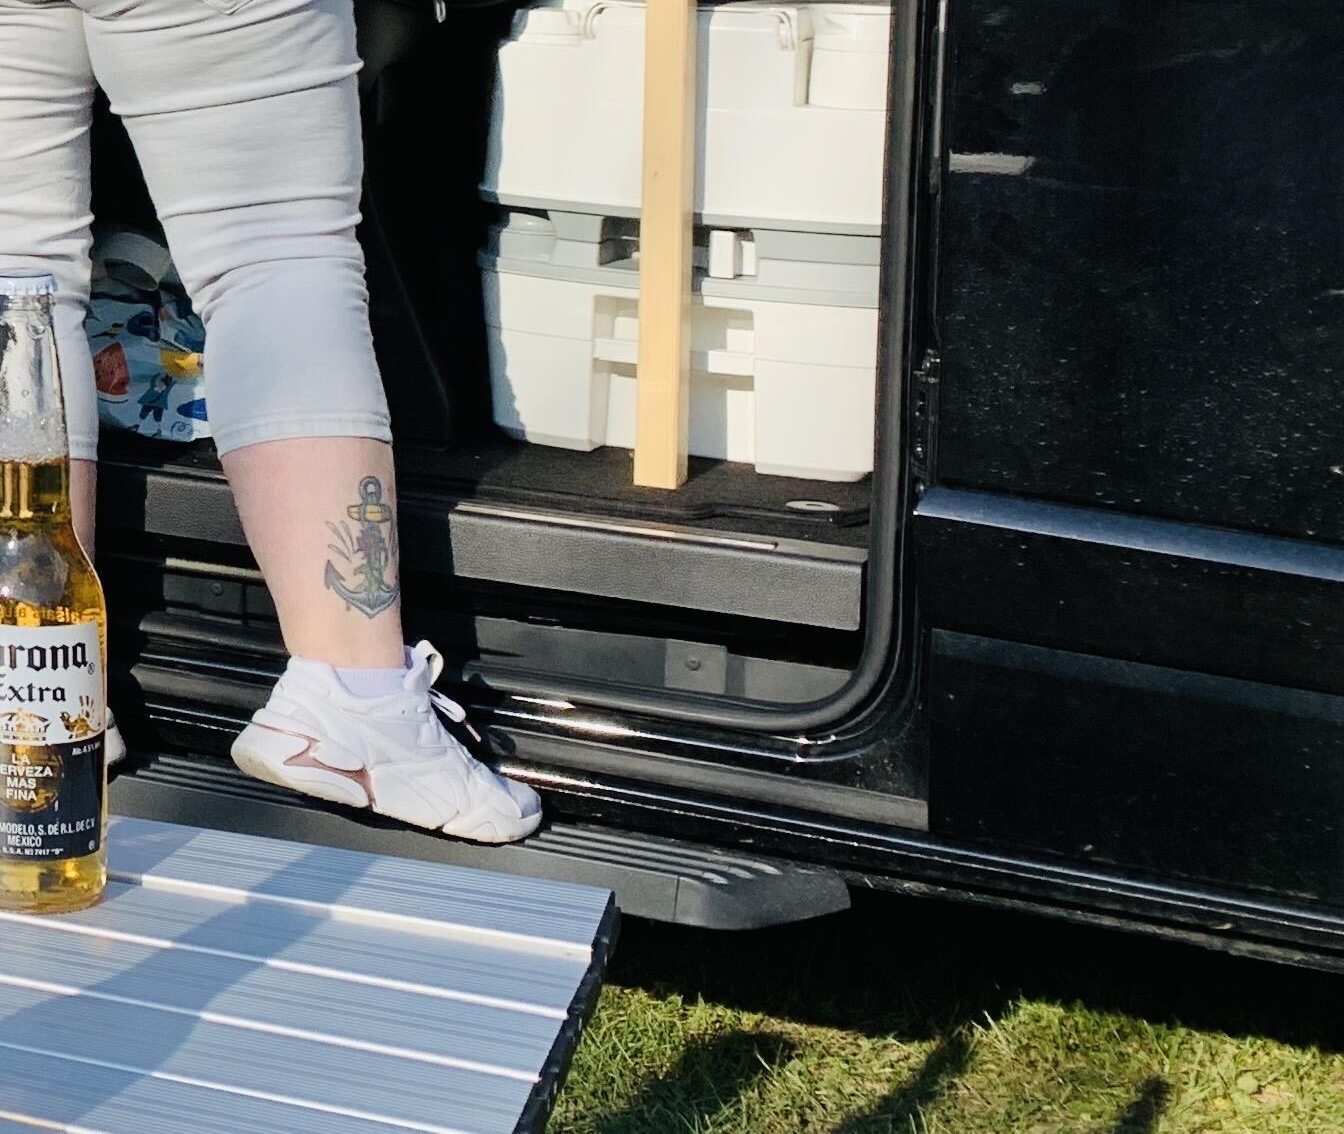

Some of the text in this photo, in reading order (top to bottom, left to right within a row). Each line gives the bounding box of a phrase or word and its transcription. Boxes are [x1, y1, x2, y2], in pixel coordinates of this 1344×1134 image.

[12, 753, 30, 765] LA
[6, 776, 37, 789] MAS
[6, 788, 37, 801] FINA
[7, 835, 43, 847] MEXICO
